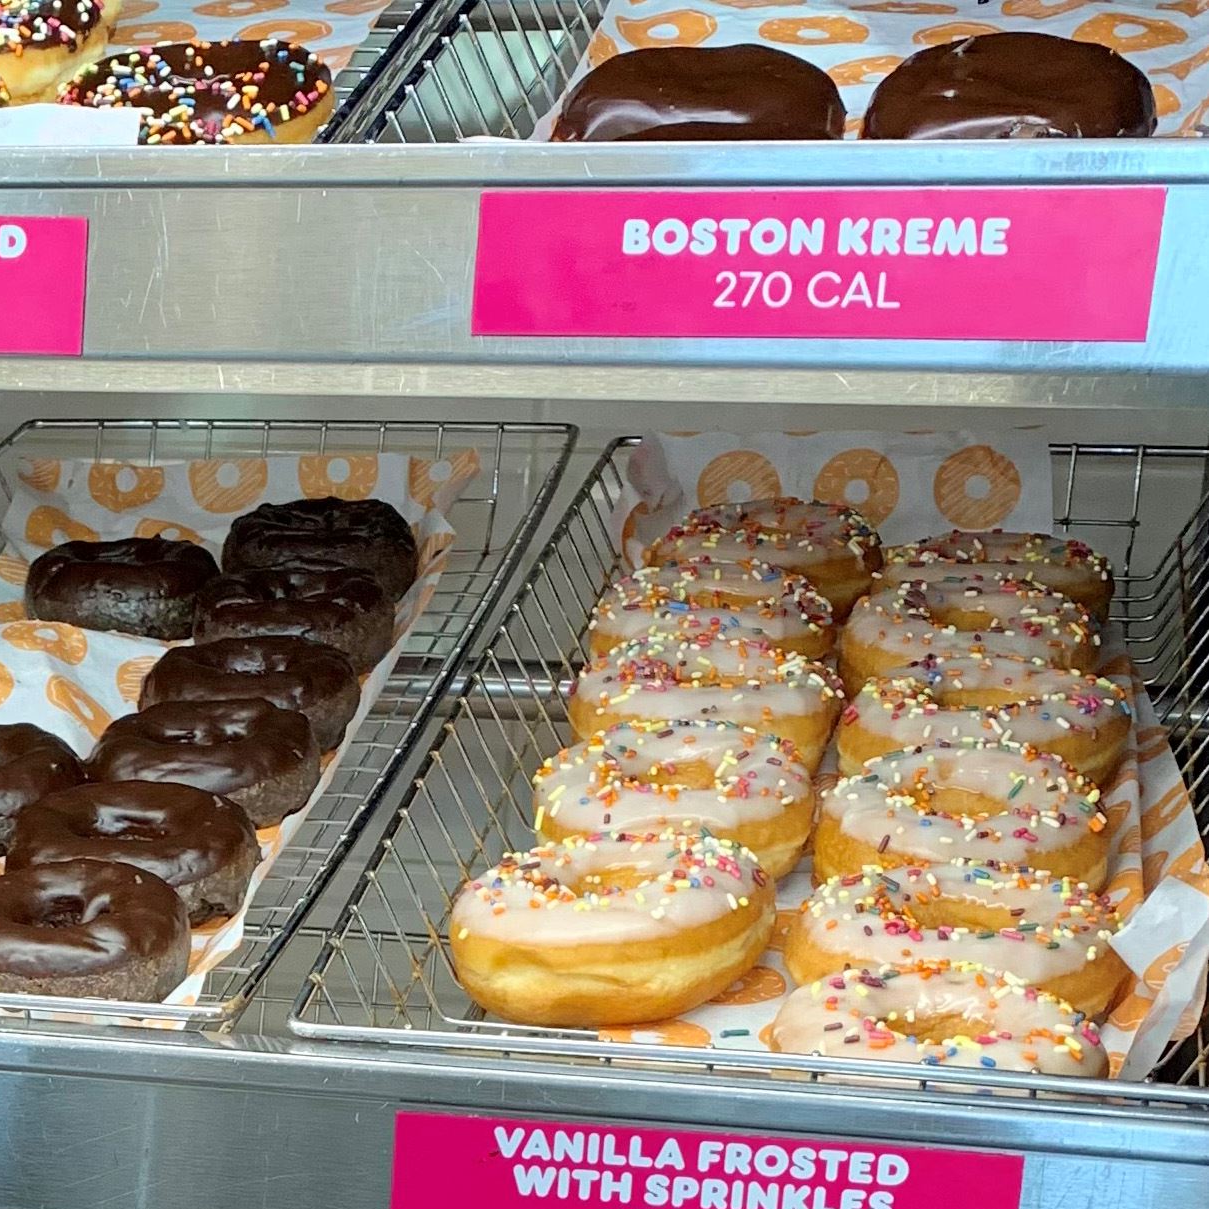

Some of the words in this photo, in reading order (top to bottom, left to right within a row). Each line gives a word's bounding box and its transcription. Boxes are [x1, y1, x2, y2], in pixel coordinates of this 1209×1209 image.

[621, 217, 826, 257] BOSTON
[837, 216, 1012, 257] KREME
[713, 270, 793, 308] 270
[806, 270, 901, 309] CAL
[493, 1126, 685, 1171] VANILLA
[697, 1140, 910, 1186] FROSTED
[513, 1164, 633, 1204] WITH
